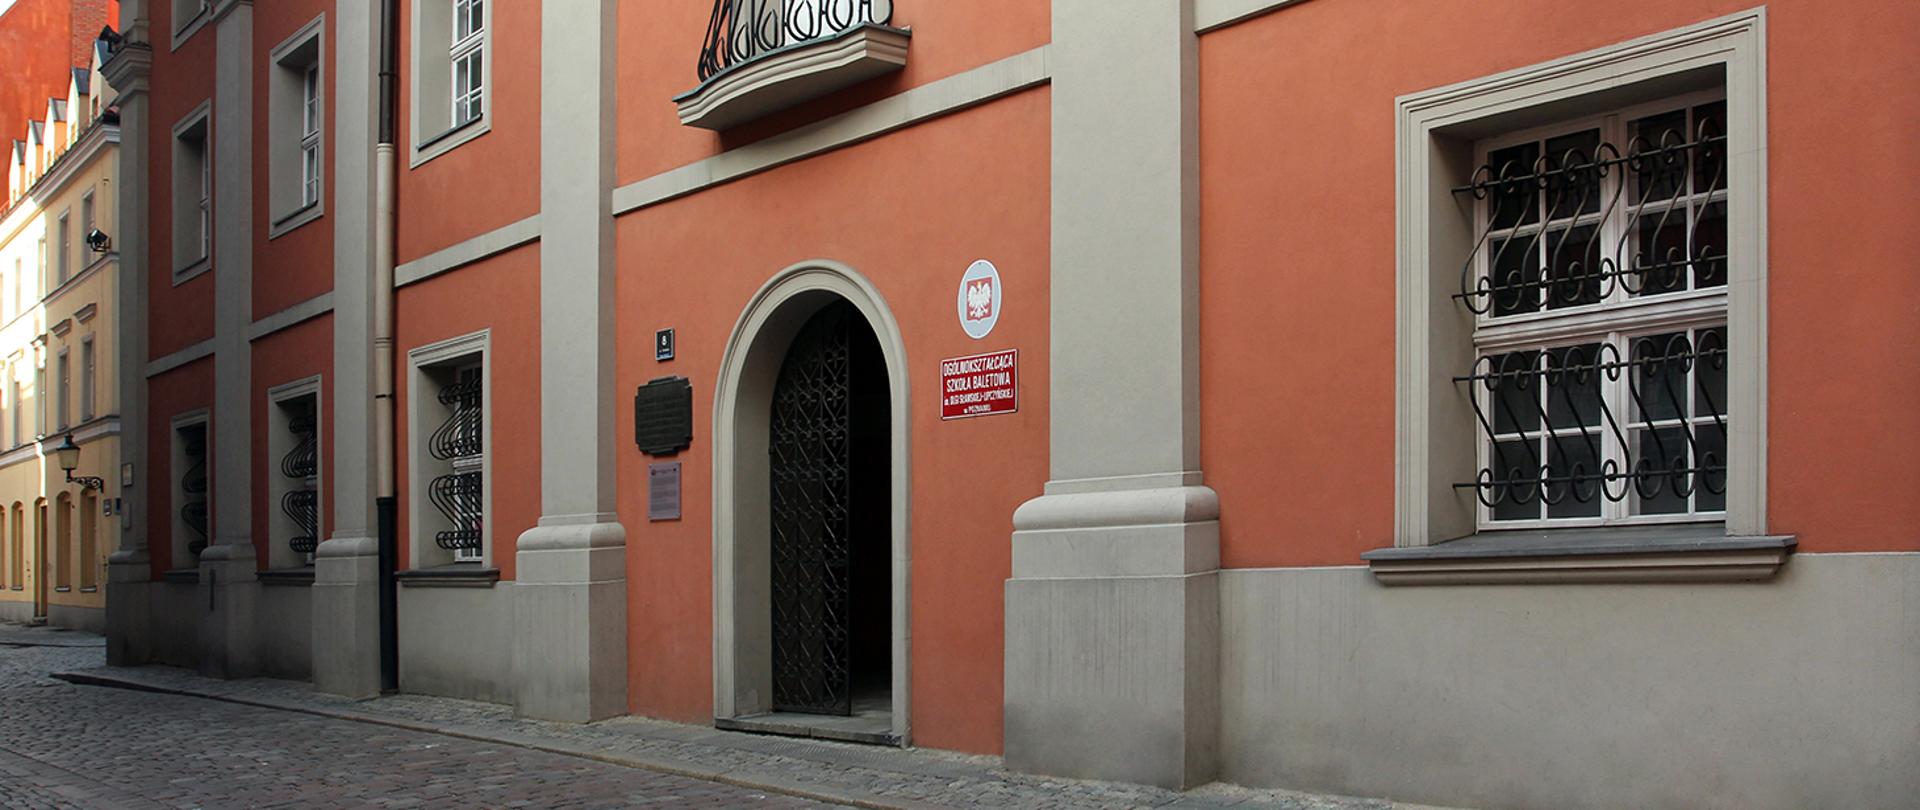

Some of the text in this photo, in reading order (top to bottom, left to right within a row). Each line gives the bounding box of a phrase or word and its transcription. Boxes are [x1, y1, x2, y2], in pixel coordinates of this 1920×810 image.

[661, 335, 667, 346] 8
[943, 354, 1013, 376] OGÓLNOKSZTAŁCĄCA
[946, 371, 1010, 393] SZKOŁA BALETOWA
